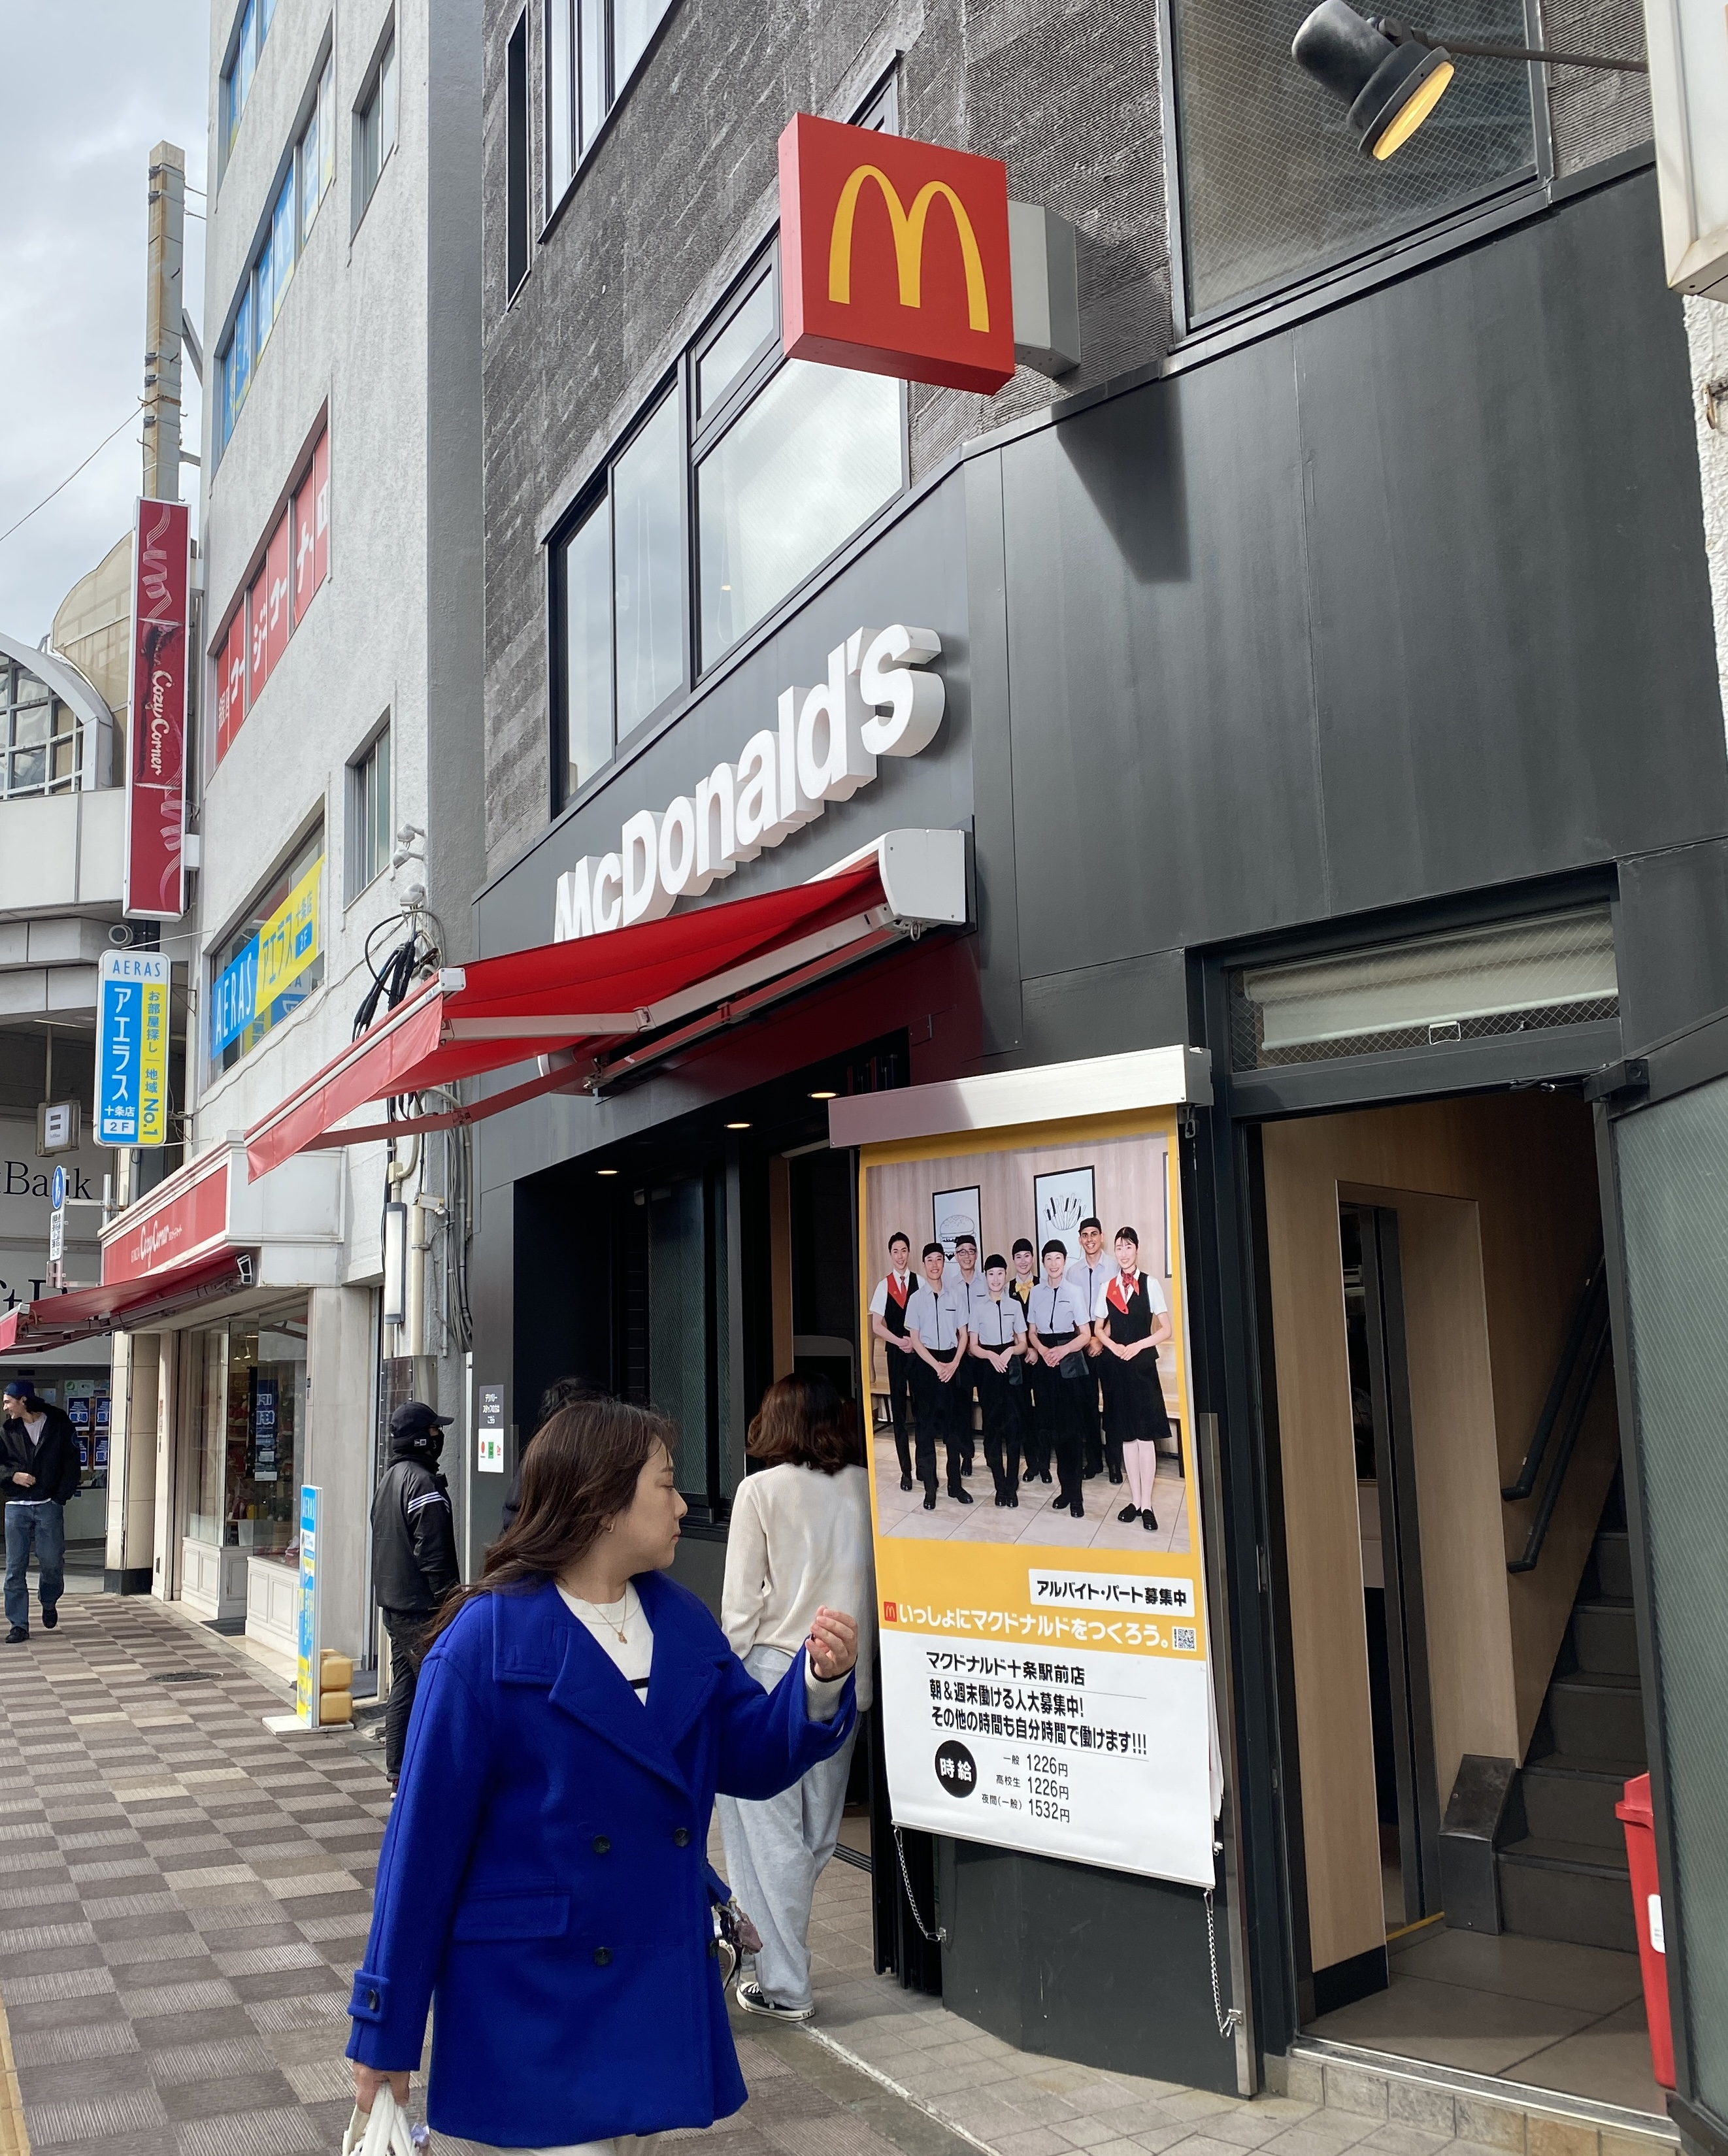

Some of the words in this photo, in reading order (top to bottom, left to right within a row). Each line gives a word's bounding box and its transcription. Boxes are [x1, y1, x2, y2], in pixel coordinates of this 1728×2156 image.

[145, 670, 173, 720] Cozy
[150, 718, 170, 776] Corner
[554, 623, 944, 943] McDonald's
[112, 959, 161, 977] AERAS
[215, 952, 252, 1046] AERAS
[111, 987, 132, 1103] アエラス
[104, 1104, 135, 1118] 十条店
[1037, 1580, 1188, 1607] アルバイト・パート募集中
[899, 1603, 1169, 1649] いっしょにマクドナルドをつくろう。
[925, 1651, 1086, 1686] マクドナルド十条駅前店
[931, 1706, 1148, 1755] その他の時間も自分時間で働けます!!!
[939, 1757, 972, 1782] 時給
[1003, 1754, 1020, 1766] 一般
[1027, 1753, 1069, 1778] 1226円
[995, 1774, 1022, 1788] 高校生
[1027, 1776, 1069, 1800] 1226円
[1029, 1798, 1071, 1824] 1532円
